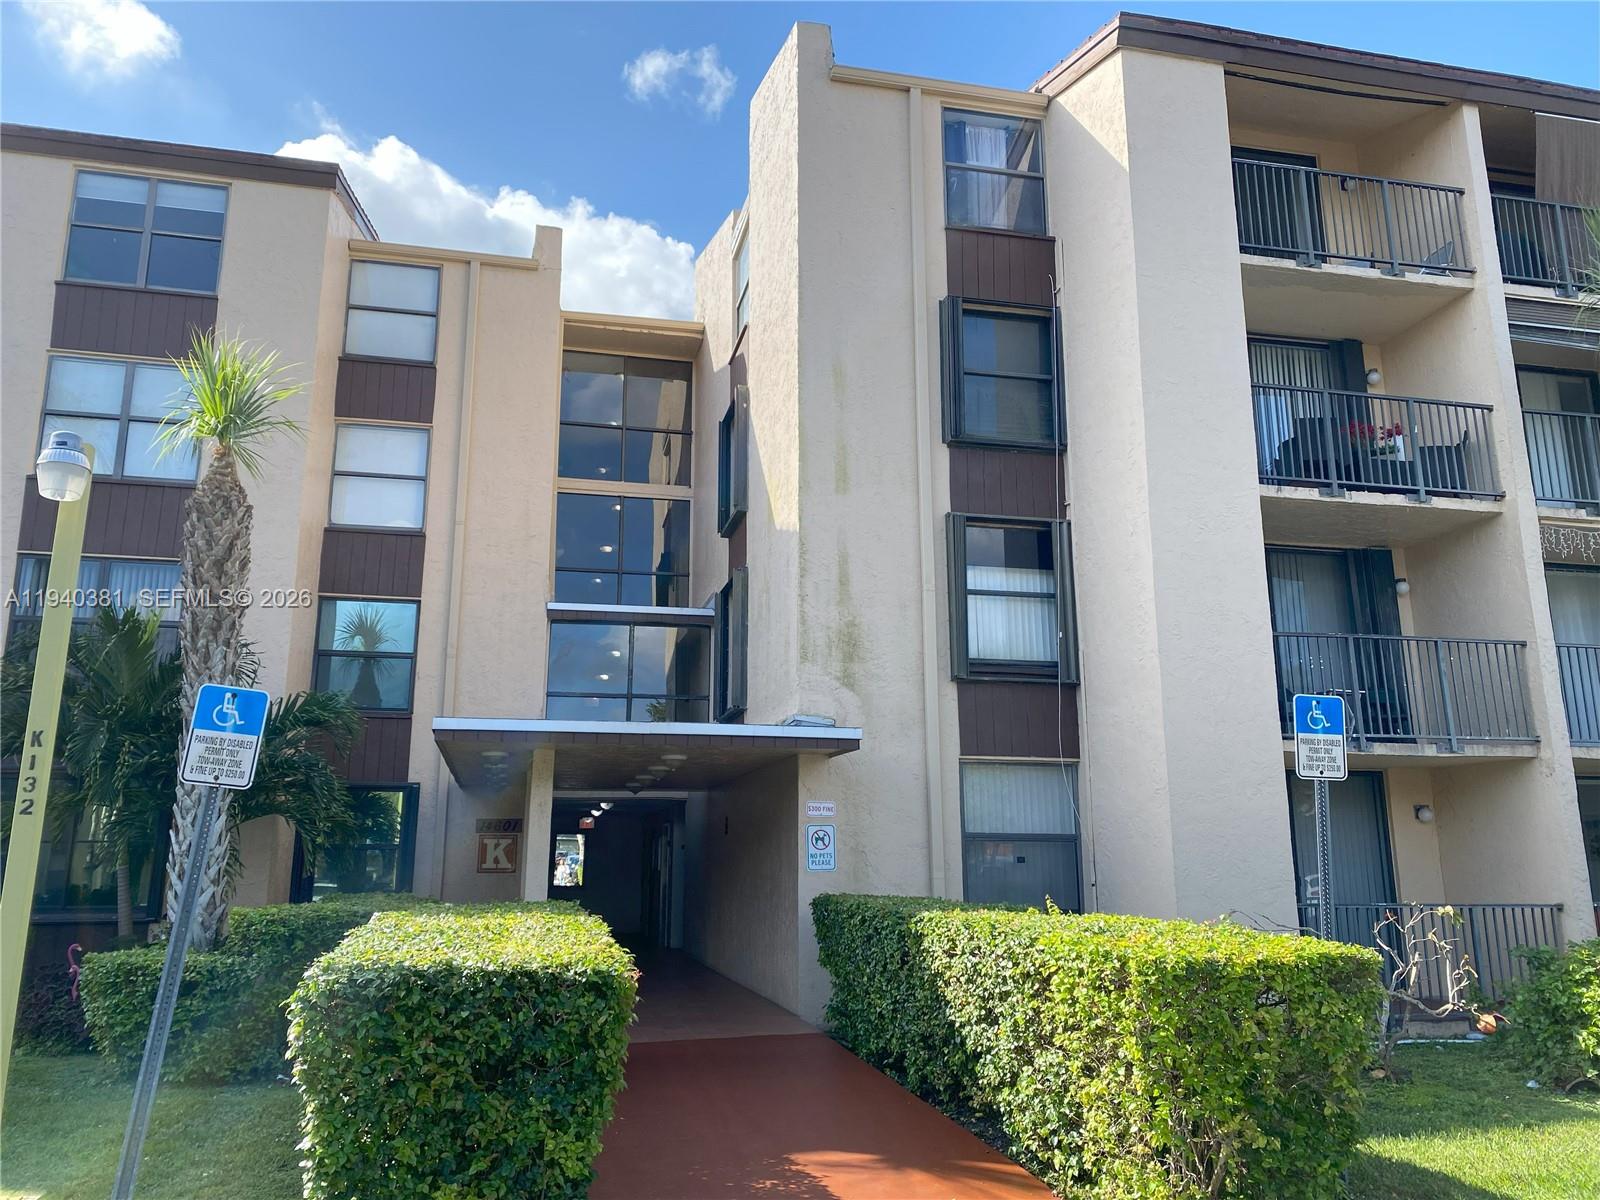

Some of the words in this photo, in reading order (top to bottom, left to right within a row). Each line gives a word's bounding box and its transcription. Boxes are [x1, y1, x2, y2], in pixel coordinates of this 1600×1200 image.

[194, 735, 218, 746] PARKING
[218, 737, 226, 747] BY
[227, 738, 254, 750] DISABLED
[1300, 737, 1316, 746] PARKING
[1317, 738, 1322, 746] BY
[1323, 738, 1341, 747] DISABLED
[204, 746, 226, 756] PERMIT
[226, 748, 239, 758] ONLY
[1309, 746, 1322, 755] PERMIT
[1323, 747, 1333, 755] ONLY
[197, 756, 228, 767] TOW-AWAY
[228, 759, 243, 769] ZONE
[1327, 756, 1337, 764] ZONE
[190, 766, 194, 774] &
[194, 766, 208, 775] FINE
[208, 767, 217, 776] UP
[217, 768, 225, 777] TO
[225, 769, 245, 780] $250.00
[481, 838, 512, 868] K
